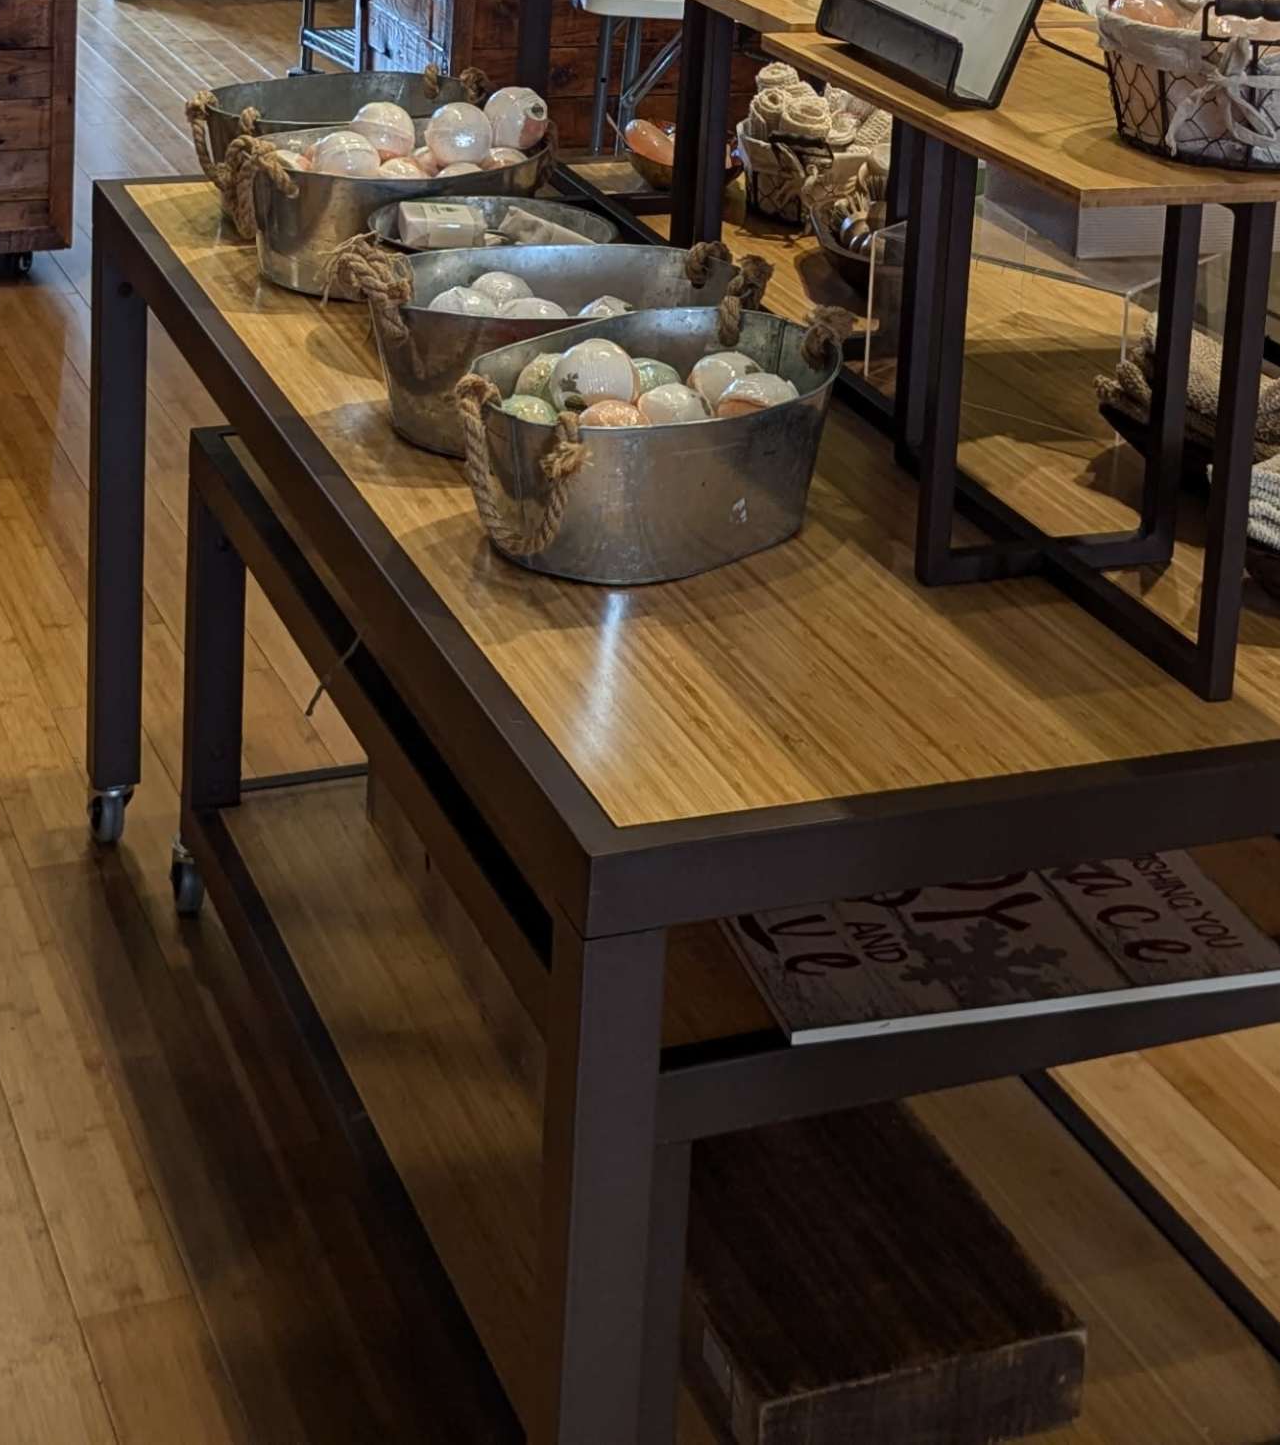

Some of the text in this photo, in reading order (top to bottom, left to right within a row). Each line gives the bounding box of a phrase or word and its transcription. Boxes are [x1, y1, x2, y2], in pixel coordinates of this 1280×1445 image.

[1065, 872, 1192, 964] ace
[1183, 909, 1245, 949] YOU
[844, 921, 909, 963] AND
